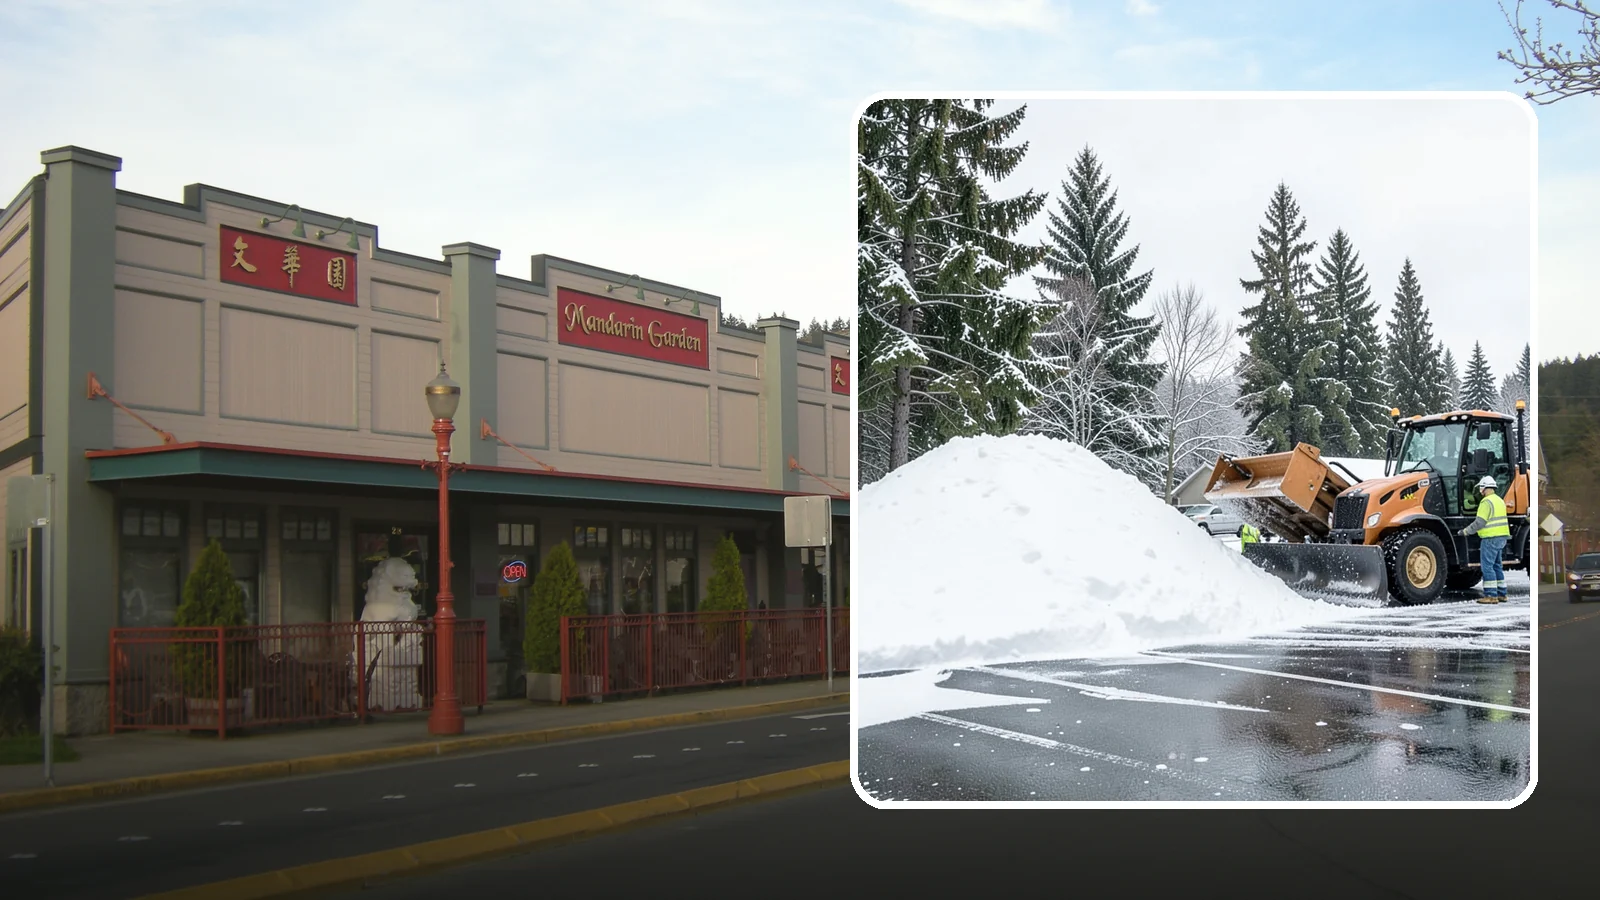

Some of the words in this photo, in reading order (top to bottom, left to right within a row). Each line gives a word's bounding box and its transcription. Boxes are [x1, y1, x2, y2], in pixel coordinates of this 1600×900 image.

[230, 236, 346, 291] 文華園
[564, 302, 644, 341] Mandarin
[648, 320, 701, 353] Garden
[503, 565, 527, 578] OPEN
